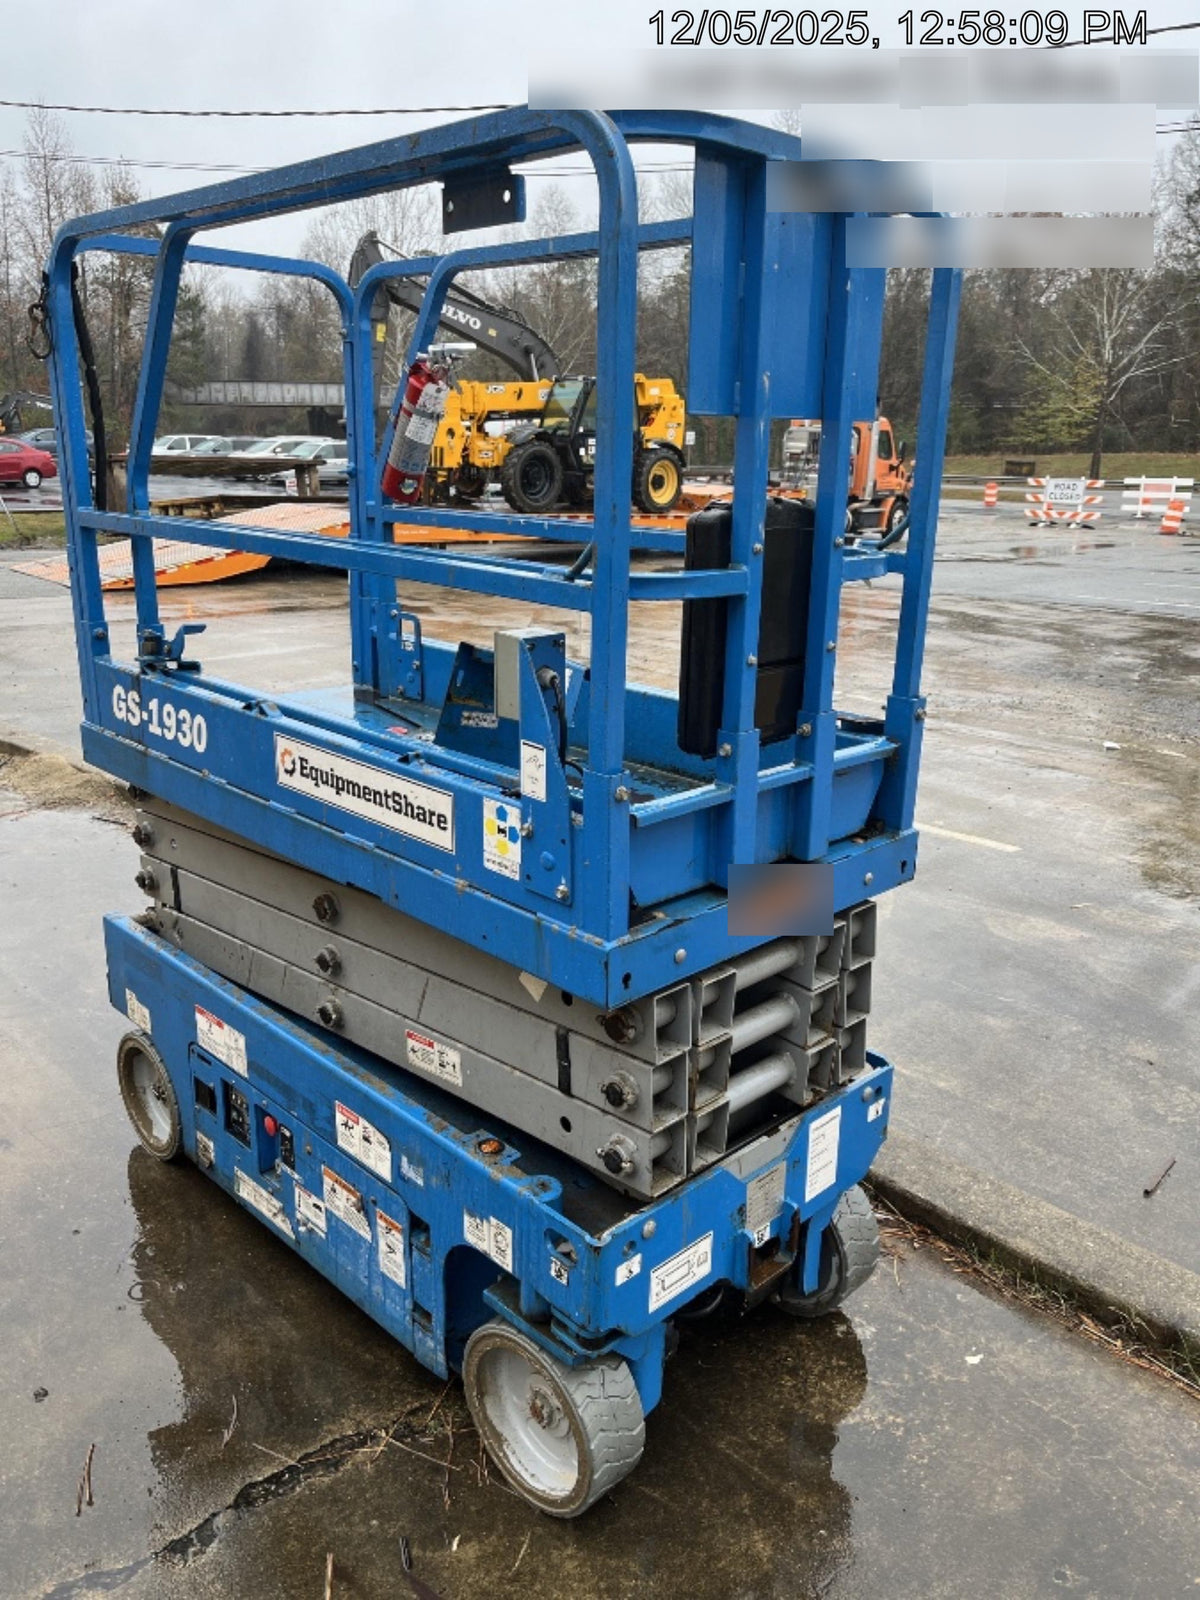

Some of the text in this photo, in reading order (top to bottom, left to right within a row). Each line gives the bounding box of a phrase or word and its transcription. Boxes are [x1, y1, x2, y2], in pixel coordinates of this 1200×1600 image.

[1054, 483, 1077, 491] ROAD
[112, 684, 207, 753] GS-1930
[298, 756, 448, 831] EquipmentShare
